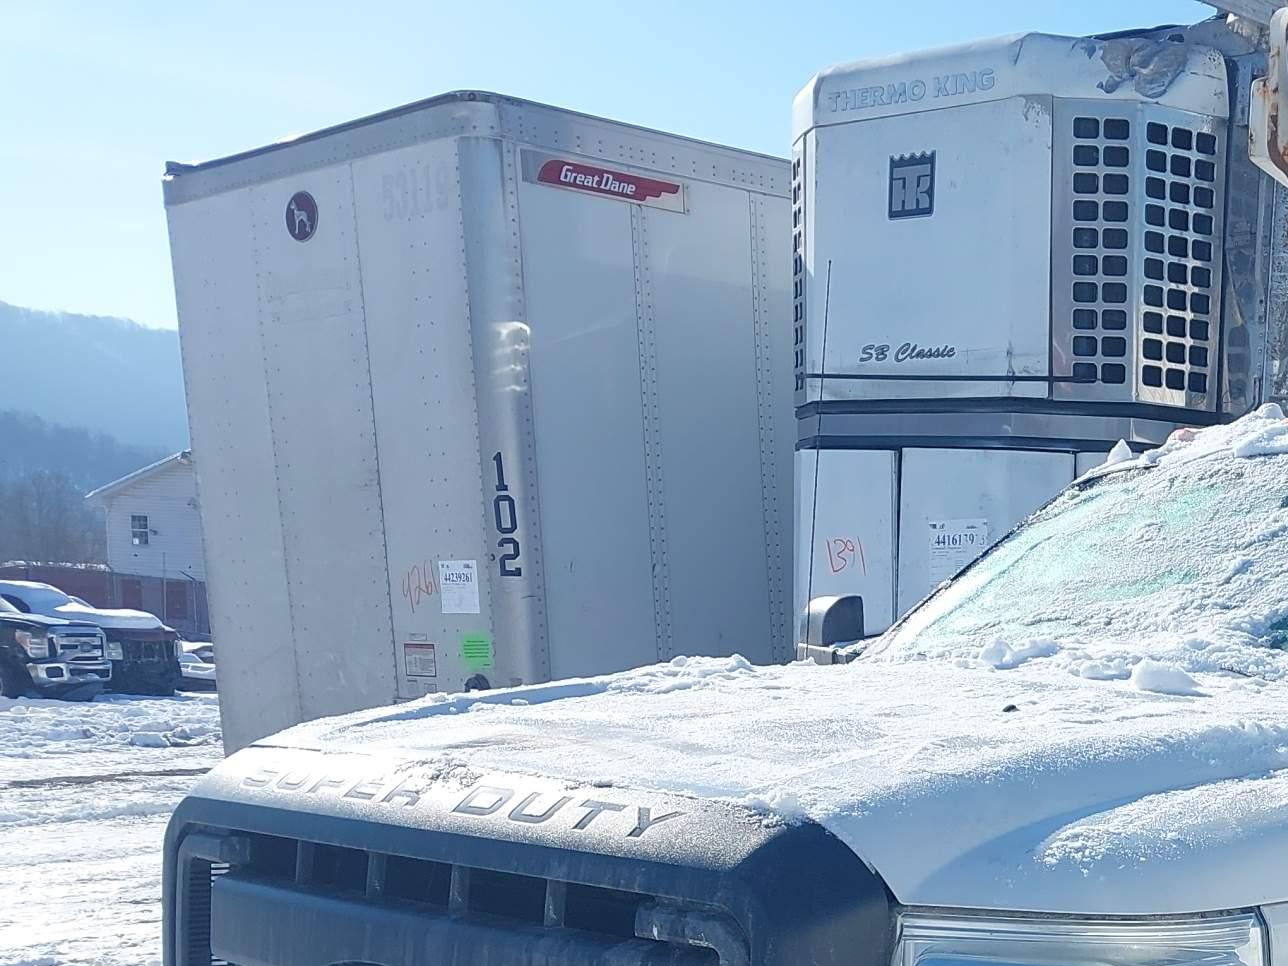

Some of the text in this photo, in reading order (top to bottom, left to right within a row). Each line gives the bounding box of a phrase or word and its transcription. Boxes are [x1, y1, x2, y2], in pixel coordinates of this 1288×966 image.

[828, 68, 996, 112] THERMO KING
[559, 165, 636, 196] Great Dane
[859, 342, 956, 363] SB Classic
[493, 451, 522, 576] 102
[242, 769, 688, 838] SUPER DUTY
